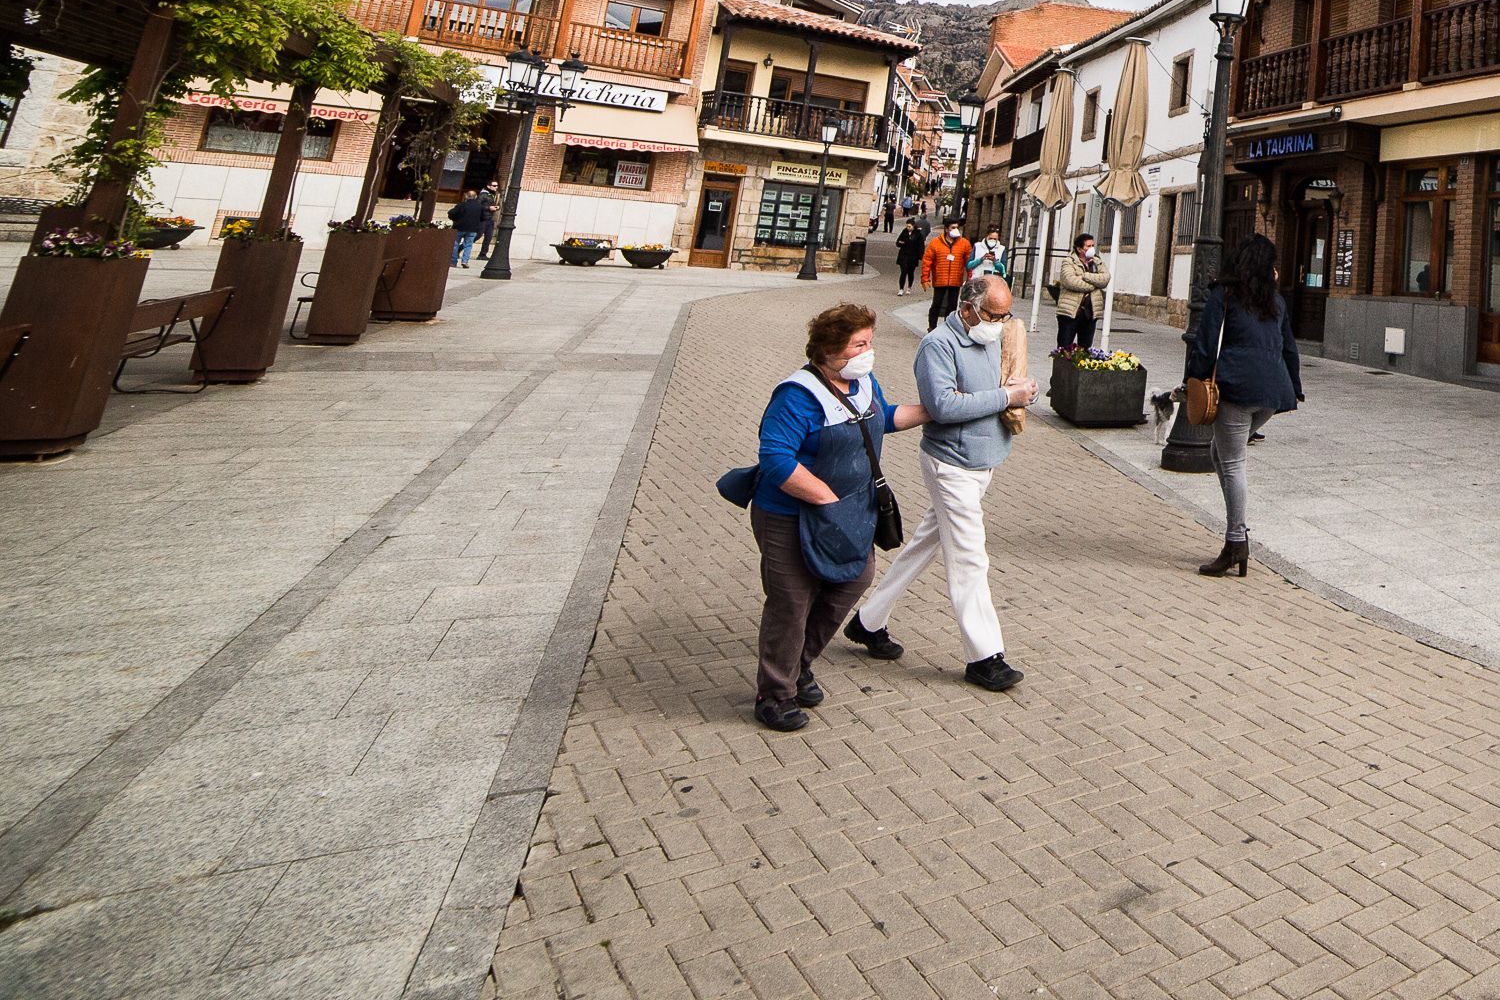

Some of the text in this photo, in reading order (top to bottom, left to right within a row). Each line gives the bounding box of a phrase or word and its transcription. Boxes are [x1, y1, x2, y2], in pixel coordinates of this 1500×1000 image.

[564, 133, 627, 149] Panadería
[1249, 133, 1314, 159] LA TAURINA
[776, 165, 842, 179] FINCAS RVÁN
